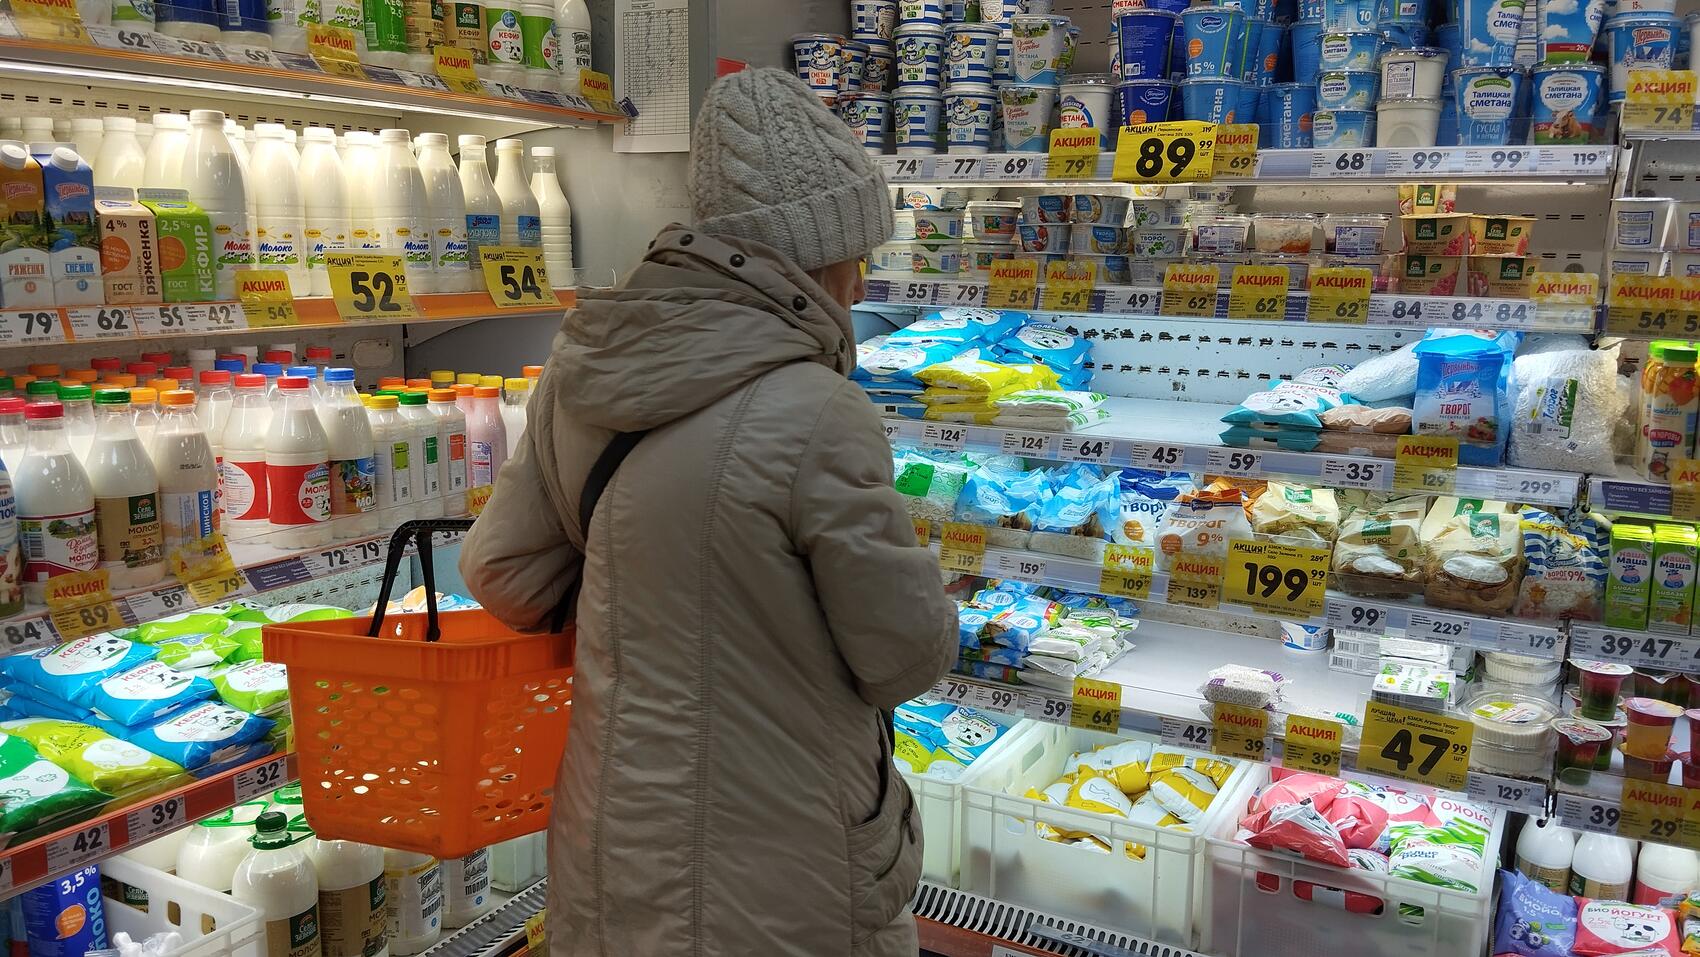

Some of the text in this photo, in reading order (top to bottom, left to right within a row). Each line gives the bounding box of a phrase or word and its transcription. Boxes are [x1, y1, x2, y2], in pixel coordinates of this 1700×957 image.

[1360, 11, 1370, 21] 10
[118, 31, 150, 48] 62
[313, 34, 353, 50] АКЦИЯ!
[177, 39, 210, 56] 32
[244, 48, 269, 63] 69
[439, 55, 470, 69] АКЦИЯ!
[338, 62, 354, 73] 59
[419, 74, 436, 86] 79
[461, 80, 476, 92] 89
[583, 76, 609, 90] АКЦИЯ!
[499, 83, 516, 97] 79
[1633, 81, 1691, 94] АКЦИЯ!
[566, 95, 583, 107] 94
[1472, 91, 1510, 99] Талицкая
[1470, 99, 1511, 108] сметана
[1283, 94, 1291, 147] сметана
[1654, 108, 1682, 124] 74
[1125, 125, 1157, 133] АКЦИЯ!
[1476, 123, 1500, 132] ГУСТАЯ
[1054, 137, 1095, 147] АКЦИЯ!
[1136, 138, 1195, 177] 89
[1230, 157, 1250, 169] 69
[1336, 153, 1364, 171] 68
[1412, 152, 1443, 169] 99
[1491, 151, 1522, 168] 99
[1573, 153, 1597, 165] 119
[897, 159, 916, 174] 74
[954, 159, 976, 173] 77
[1004, 158, 1028, 173] 69
[1065, 160, 1085, 172] 79
[260, 243, 293, 253] Молоко
[139, 220, 158, 296] ряженка
[195, 225, 214, 292] КЕФИР
[327, 257, 355, 266] АКЦИЯ!
[484, 252, 505, 261] АКЦИЯ!
[8, 264, 45, 275] РЯЖЕНКА
[65, 264, 95, 274] СНЕЖОК
[994, 269, 1033, 278] АКЦИЯ!
[501, 266, 542, 300] 54
[1169, 273, 1214, 284] АКЦИЯ!
[1236, 275, 1283, 286] АКЦИЯ!
[1316, 277, 1365, 288] АКЦИЯ!
[242, 280, 285, 293] АКЦИЯ!
[351, 272, 405, 312] 52 99
[906, 284, 928, 299] 55
[957, 286, 978, 301] 79
[1536, 285, 1592, 295] АКЦИЯ!
[1617, 286, 1674, 298] АКЦИЯ!
[1009, 290, 1027, 304] 54
[1060, 292, 1081, 305] 54
[1127, 294, 1148, 307] 49
[1188, 297, 1206, 309] 62
[1255, 298, 1277, 312] 62
[1335, 302, 1359, 317] 62
[1392, 301, 1422, 318] 84
[208, 306, 234, 324] 42
[268, 305, 287, 320] 54
[1452, 304, 1482, 321] 84
[1496, 304, 1527, 322] 84
[19, 313, 52, 335] 79
[97, 310, 127, 330] 62
[1639, 312, 1667, 329] 54
[1440, 403, 1471, 415] ТВОРОГ
[941, 430, 960, 441] 124
[1021, 437, 1043, 449] 124
[1080, 441, 1103, 456] 64
[1152, 447, 1177, 463] 45
[1402, 444, 1452, 458] АКЦИЯ!
[1229, 453, 1254, 470] 59
[1347, 463, 1374, 480] 35
[1422, 474, 1445, 486] 129
[1520, 482, 1551, 493] 299
[128, 523, 159, 535] МОЛОКО
[945, 531, 982, 543] АКЦИЯ!
[355, 541, 379, 559] 79
[1234, 543, 1267, 553] АКЦИЯ!
[321, 550, 346, 567] 72
[957, 554, 974, 565] 119
[1617, 557, 1647, 566] Маша
[1660, 561, 1691, 570] Маша
[1020, 563, 1039, 574] 159
[1176, 563, 1218, 576] АКЦИЯ!
[1245, 562, 1325, 602] 199 99
[1568, 571, 1585, 581] 9%
[53, 579, 104, 599] АКЦИЯ!
[218, 579, 239, 593] 79
[1123, 578, 1143, 590] 109
[1186, 586, 1207, 599] 139
[162, 595, 182, 608] 89
[80, 606, 108, 625] 89
[1351, 607, 1379, 626] 99
[5, 623, 41, 640] 84
[1433, 622, 1462, 635] 229
[1529, 634, 1555, 649] 179
[1601, 635, 1633, 653] 39
[1640, 637, 1673, 658] 47
[947, 682, 968, 698] 79
[1077, 687, 1117, 700] АКЦИЯ!
[992, 692, 1013, 707] 99
[1044, 701, 1066, 717] 59
[1092, 711, 1111, 725] 64
[1219, 713, 1262, 728] АКЦИЯ!
[1183, 725, 1207, 743] 42
[1290, 725, 1336, 740] АКЦИЯ!
[1245, 740, 1264, 752] 39
[1381, 729, 1467, 775] 47 99
[1312, 752, 1331, 766] 39
[256, 764, 280, 786] 32
[1497, 785, 1523, 800] 129
[1628, 791, 1682, 807] АКЦИЯ!
[151, 802, 177, 824] 39
[1590, 805, 1620, 827] 39
[1650, 819, 1677, 837] 29
[73, 829, 102, 852] 42
